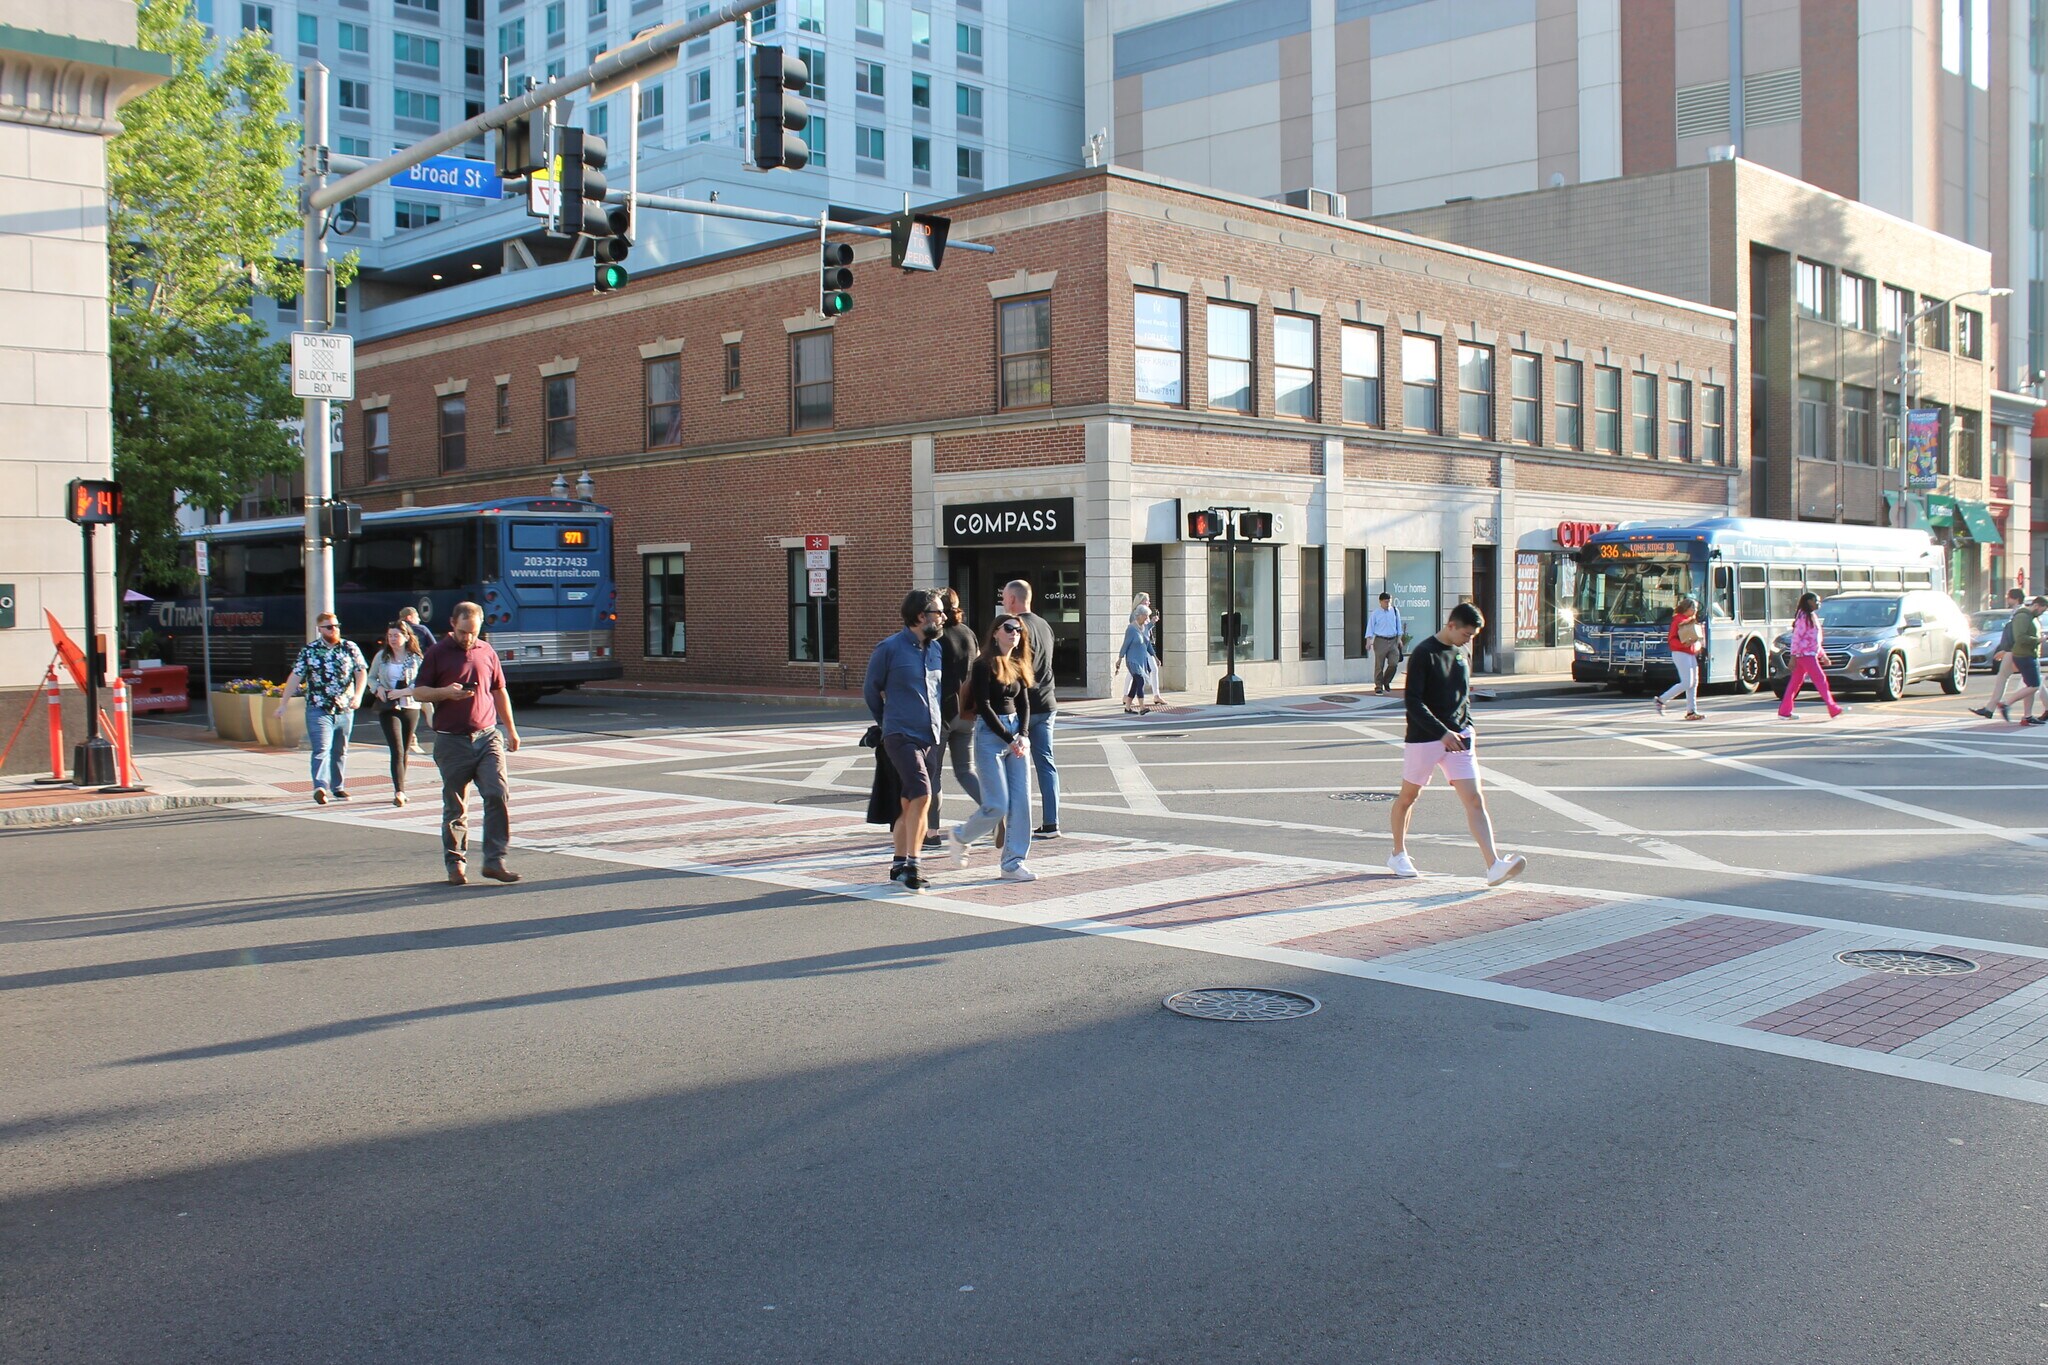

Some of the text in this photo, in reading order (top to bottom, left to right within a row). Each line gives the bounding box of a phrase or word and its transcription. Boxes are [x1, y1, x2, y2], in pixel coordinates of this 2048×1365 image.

[410, 163, 481, 189] Broad St
[913, 237, 925, 249] TO
[303, 336, 341, 349] DO NOT
[298, 369, 348, 383] BLOCK THE
[313, 383, 333, 394] BOX
[97, 491, 112, 515] 14
[953, 509, 1057, 535] COMPASS
[564, 531, 583, 544] 971
[1600, 544, 1619, 558] 336
[1630, 543, 1645, 551] LONG
[1647, 543, 1664, 551] RIDGE
[524, 556, 588, 567] 203-327-7433
[1517, 554, 1538, 565] FLOOR
[510, 568, 600, 578] www.cttransit.com
[1517, 567, 1538, 579] SAMPLE
[1393, 583, 1427, 593] Your home
[1516, 581, 1539, 591] SALE
[1044, 592, 1077, 600] COMPASS
[1393, 597, 1431, 608] Our mission
[1517, 593, 1539, 628] 50%
[213, 611, 264, 631] express
[1516, 630, 1538, 639] OFF
[1581, 625, 1599, 633] 1424
[134, 694, 187, 705] DOWNTOWN
